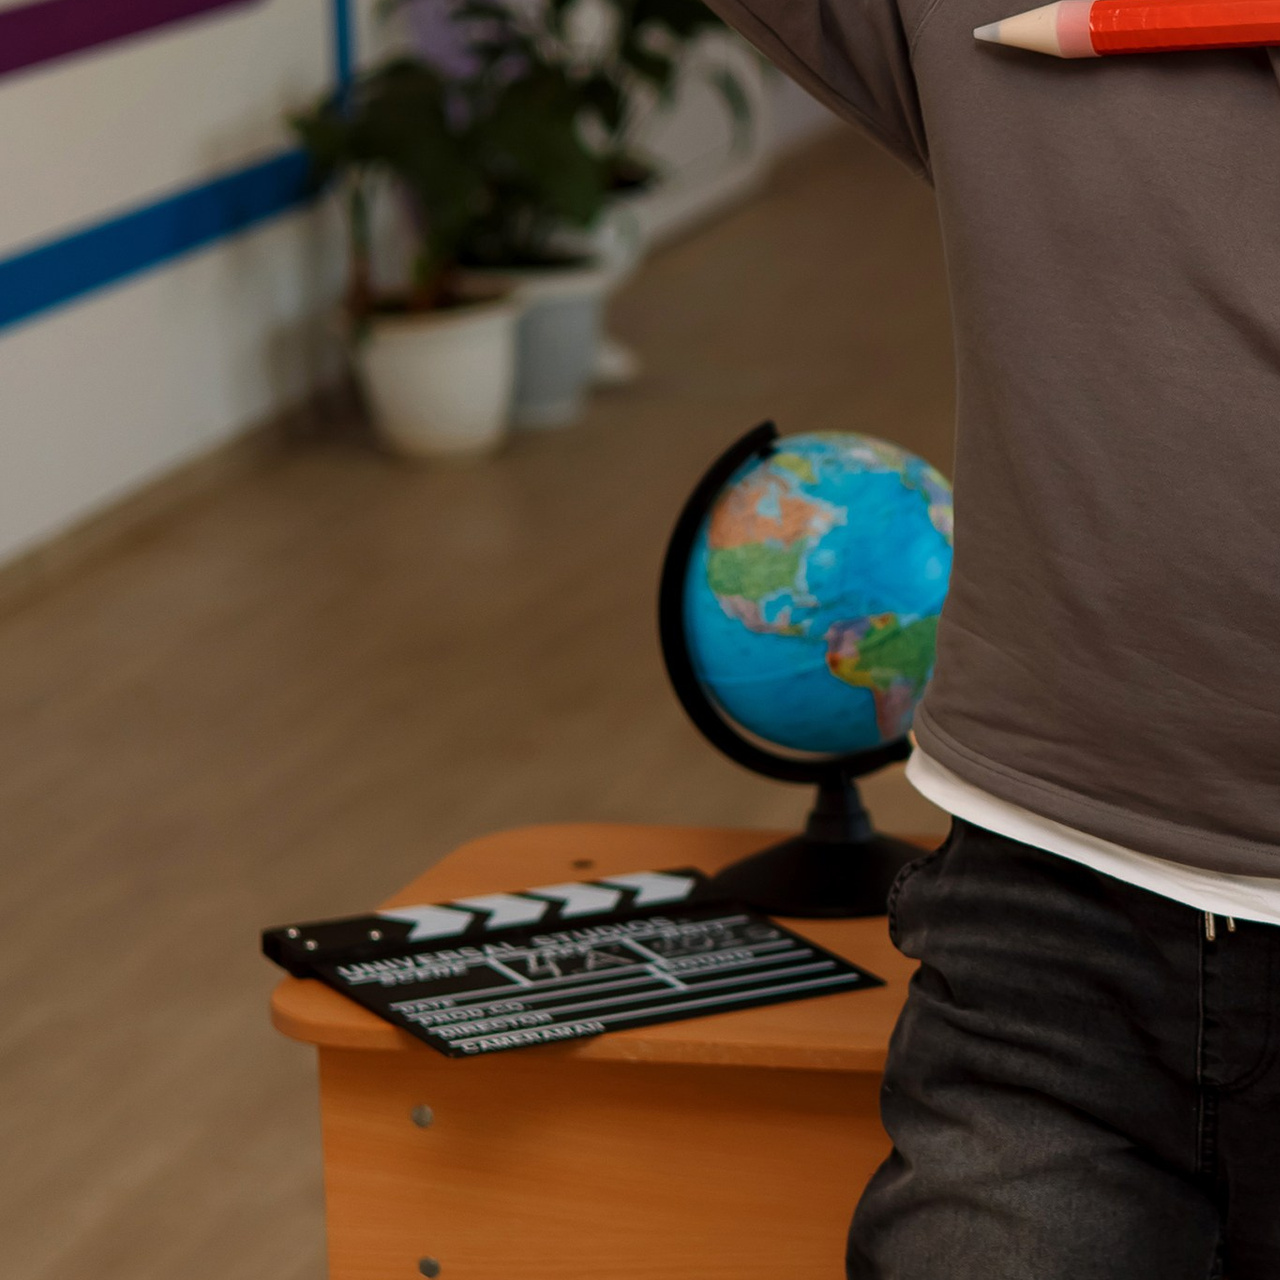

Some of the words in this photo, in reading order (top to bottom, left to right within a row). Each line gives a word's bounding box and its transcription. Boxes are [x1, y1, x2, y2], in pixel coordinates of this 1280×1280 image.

[338, 939, 527, 979] UNIVERSAL
[531, 916, 677, 947] STUDIOS
[400, 997, 456, 1015] DATE
[437, 1011, 553, 1040] DIRECTOR
[460, 1020, 606, 1055] CAMERAMAN
